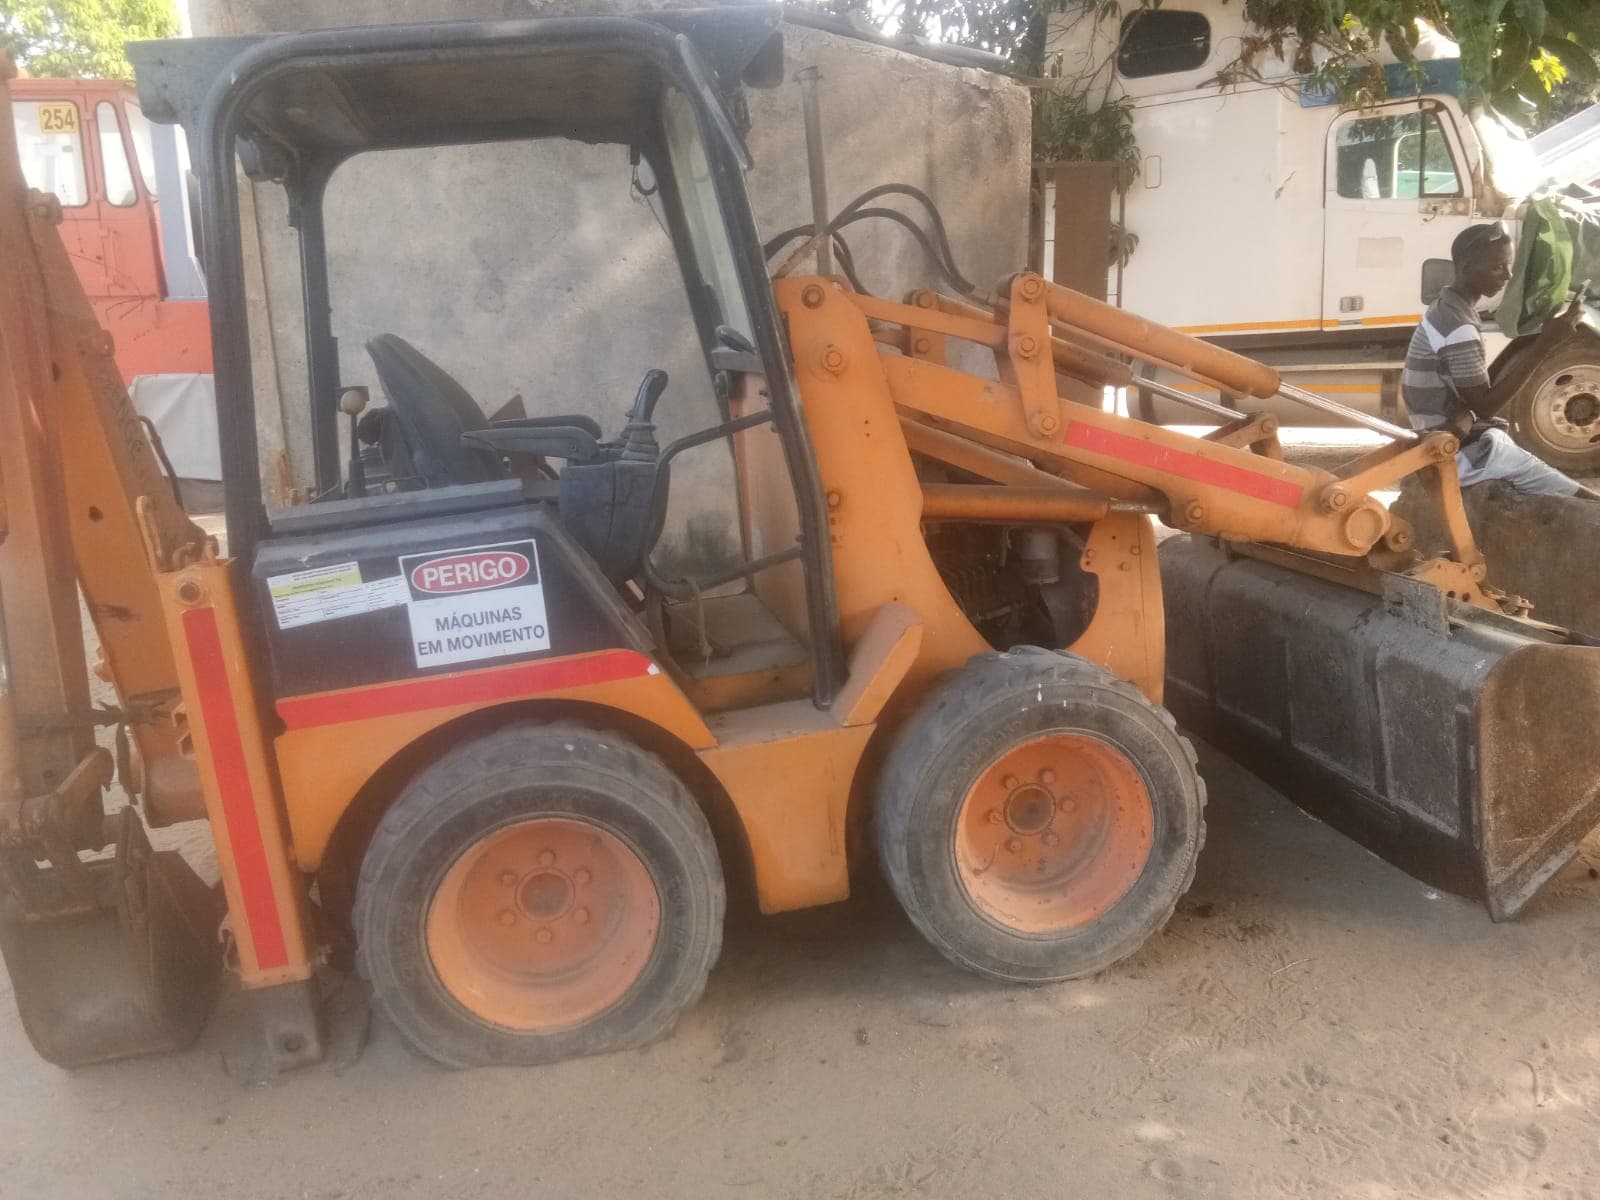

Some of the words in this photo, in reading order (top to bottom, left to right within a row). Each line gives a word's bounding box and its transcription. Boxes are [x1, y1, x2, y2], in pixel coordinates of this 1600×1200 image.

[43, 109, 75, 129] 254
[422, 557, 517, 589] PERIGO
[435, 606, 522, 632] MÁQUINAS
[418, 639, 443, 656] EM
[447, 624, 545, 651] MOVIMENTO
